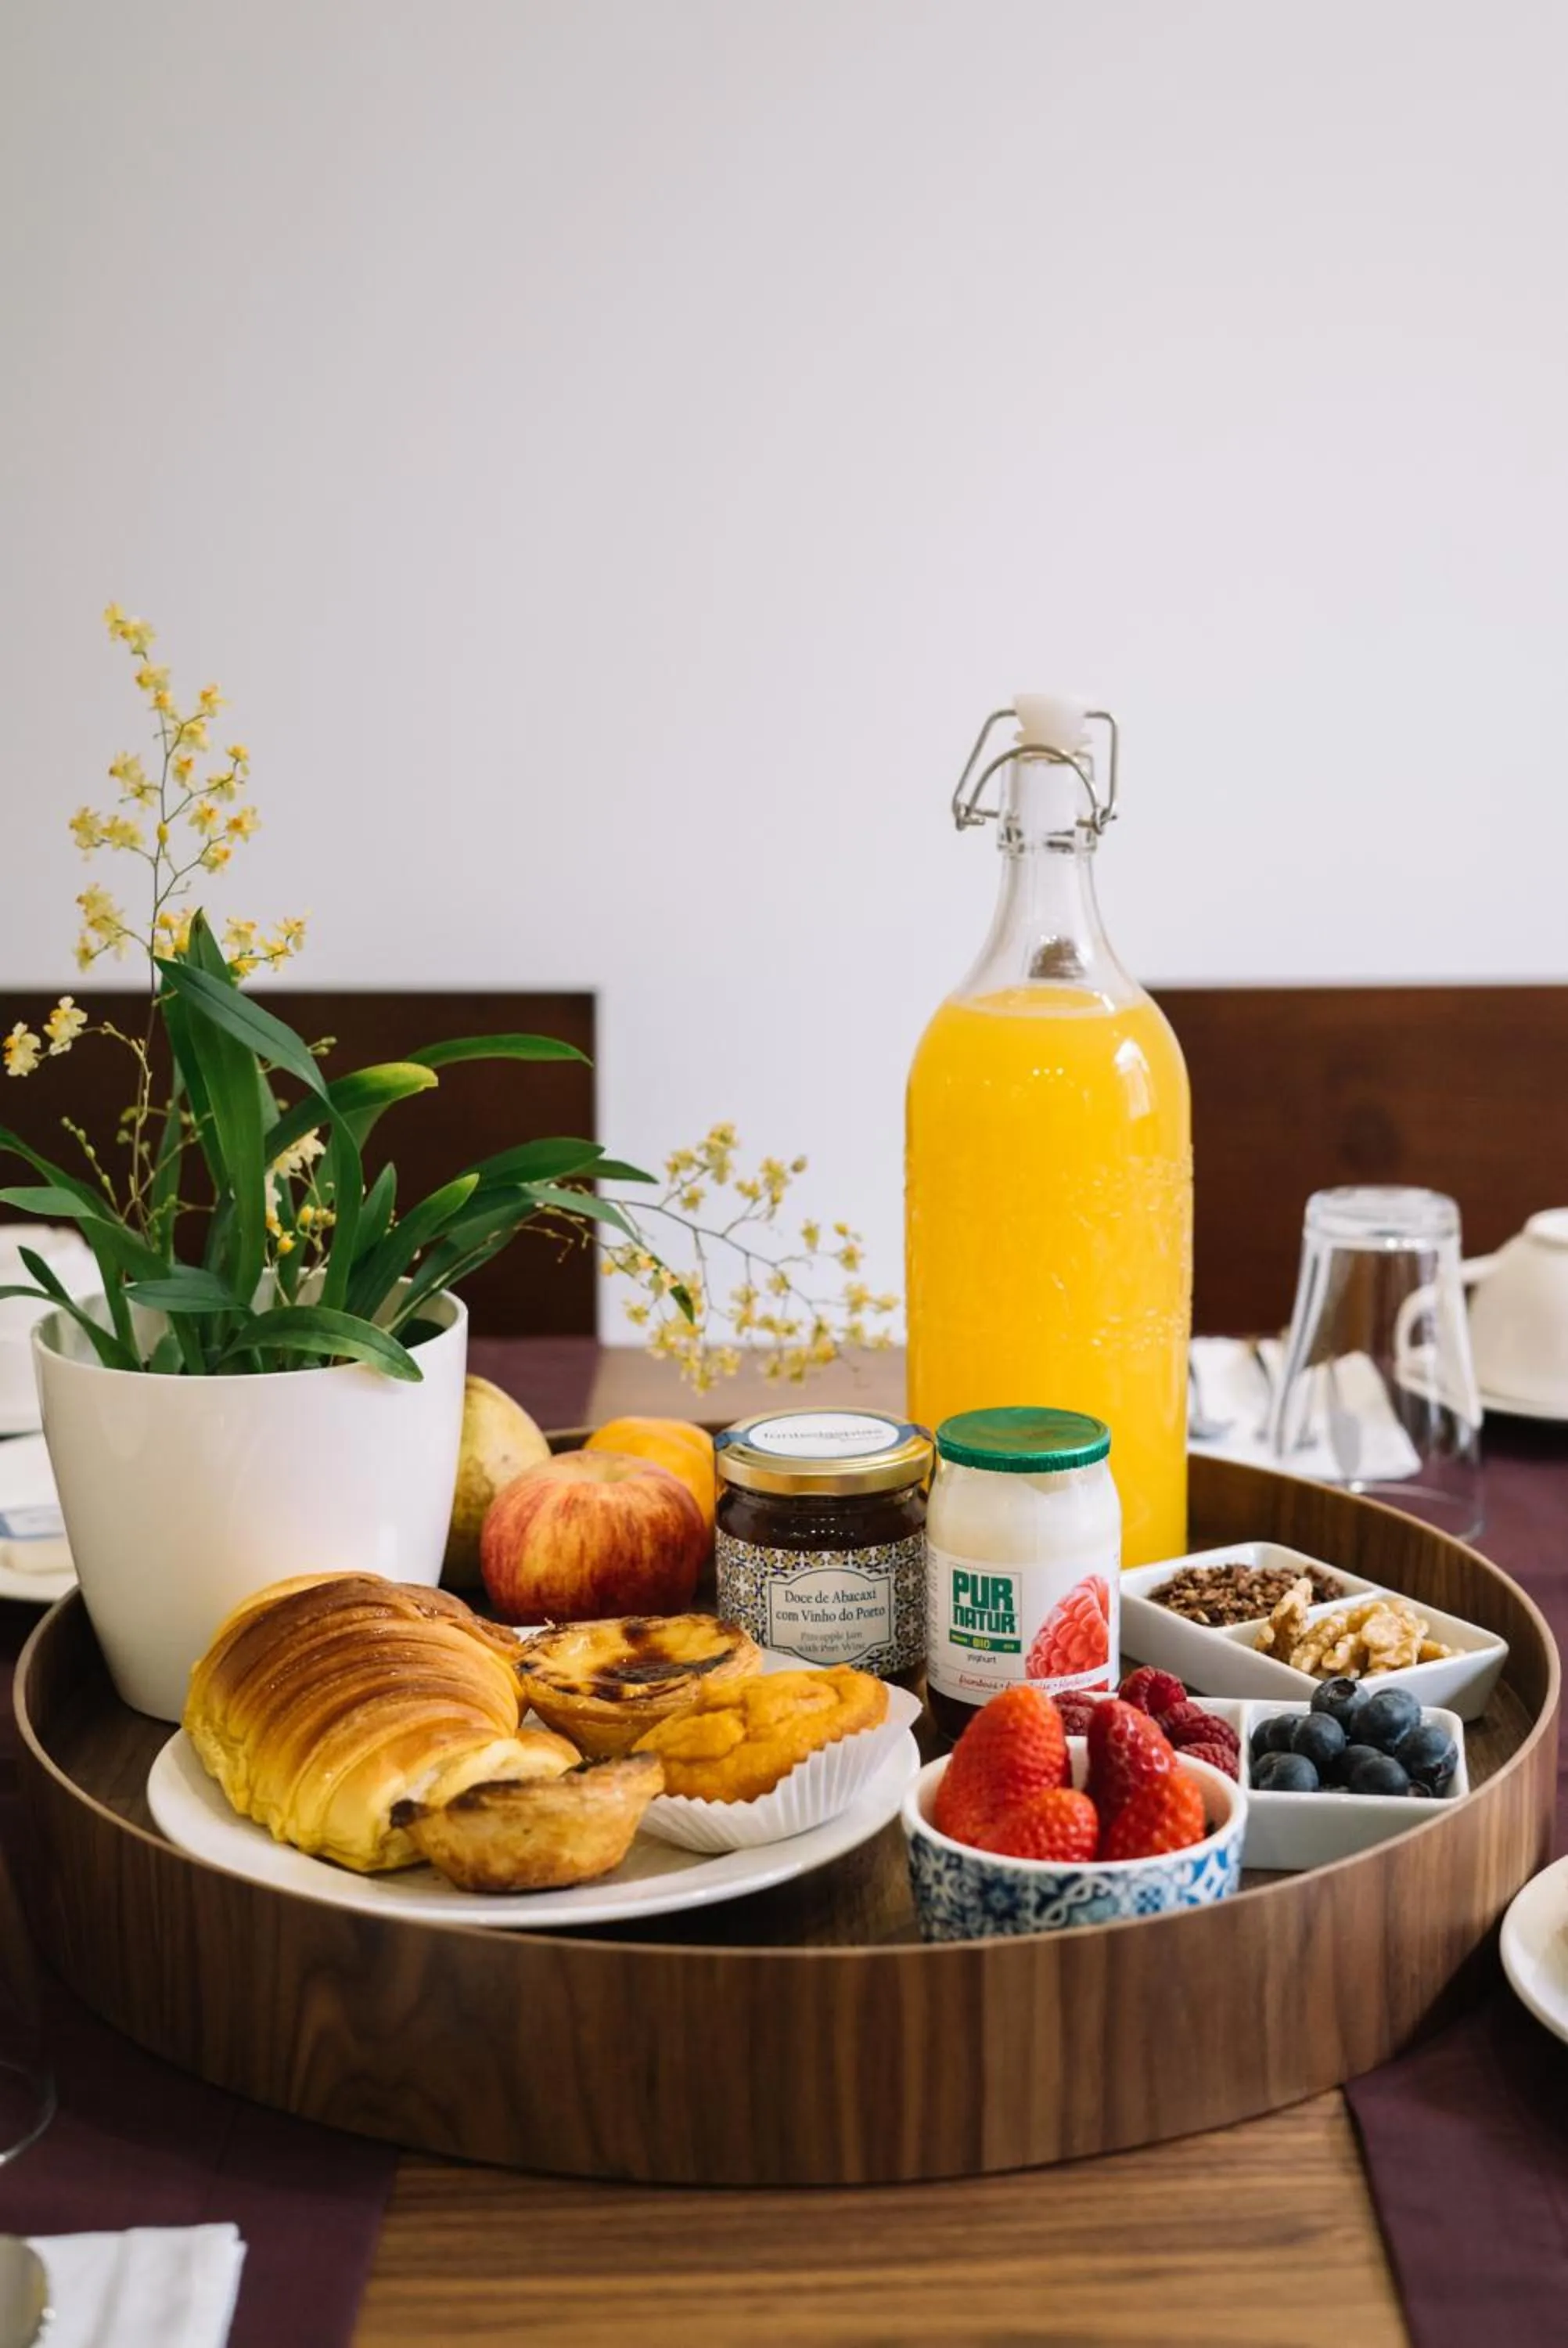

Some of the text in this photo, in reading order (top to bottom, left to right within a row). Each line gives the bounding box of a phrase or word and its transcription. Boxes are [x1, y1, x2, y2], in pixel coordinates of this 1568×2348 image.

[785, 1588, 876, 1603] Doce de Abacaxi
[953, 1569, 1013, 1612] PUR
[775, 1607, 885, 1622] com Vinho do Porto
[954, 1604, 1016, 1634] NATUR
